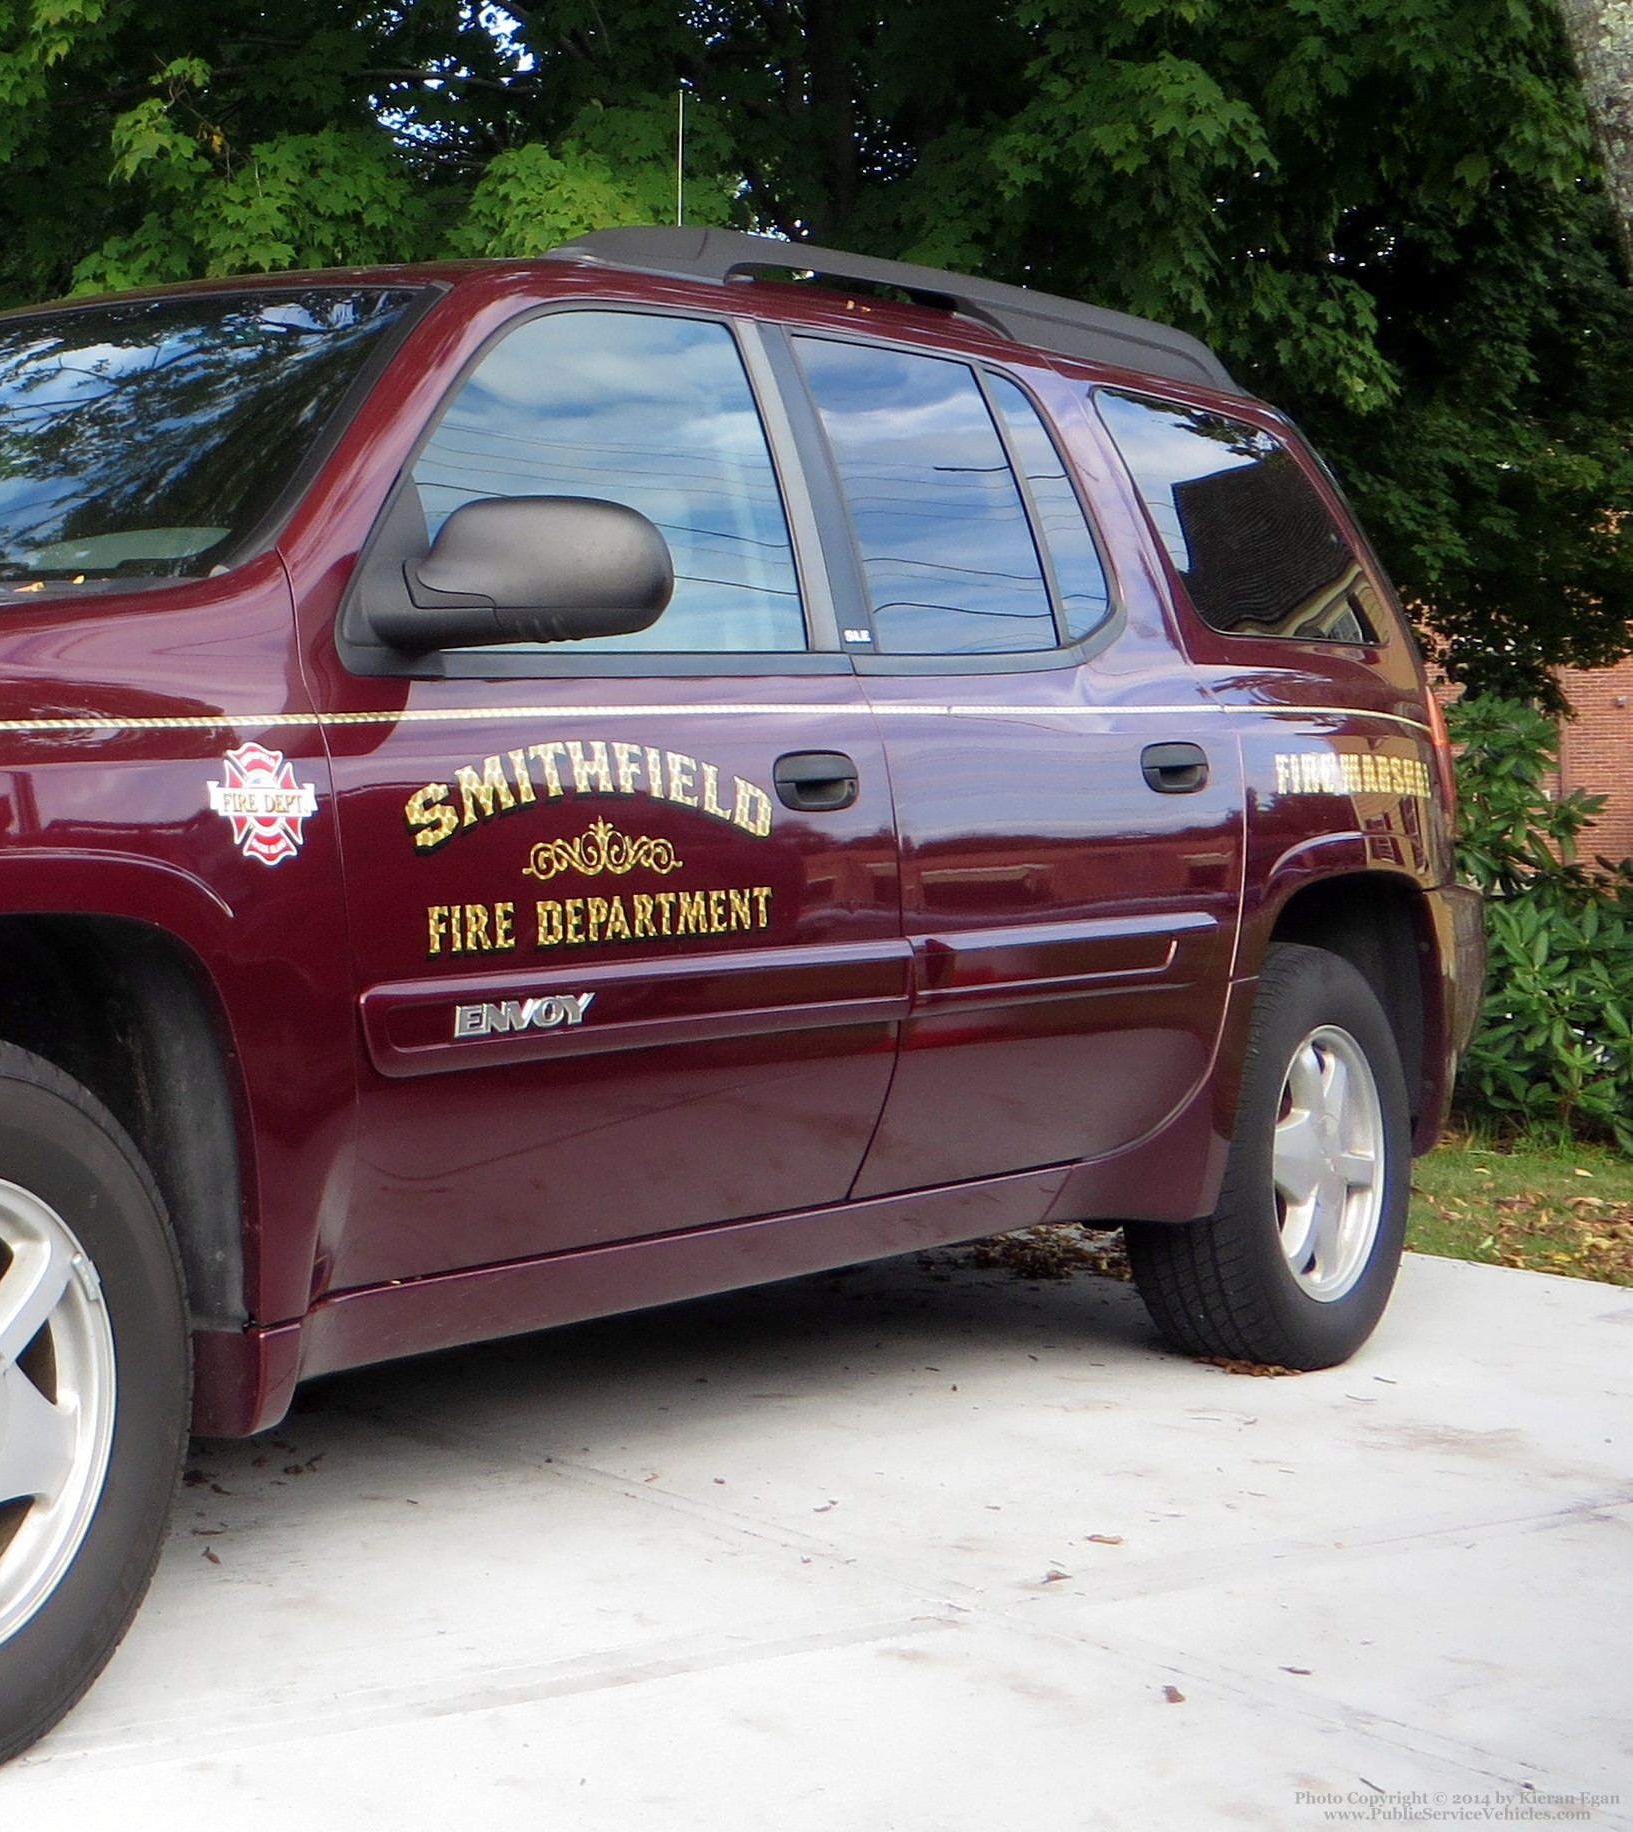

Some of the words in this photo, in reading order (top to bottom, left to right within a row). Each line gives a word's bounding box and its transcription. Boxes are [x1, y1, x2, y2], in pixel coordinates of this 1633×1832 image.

[223, 793, 258, 813] FIRE
[404, 740, 774, 850] SMITHFIELD
[426, 900, 516, 955] FIRE
[535, 886, 773, 948] DEPARTMENT
[453, 992, 596, 1039] ENVOY
